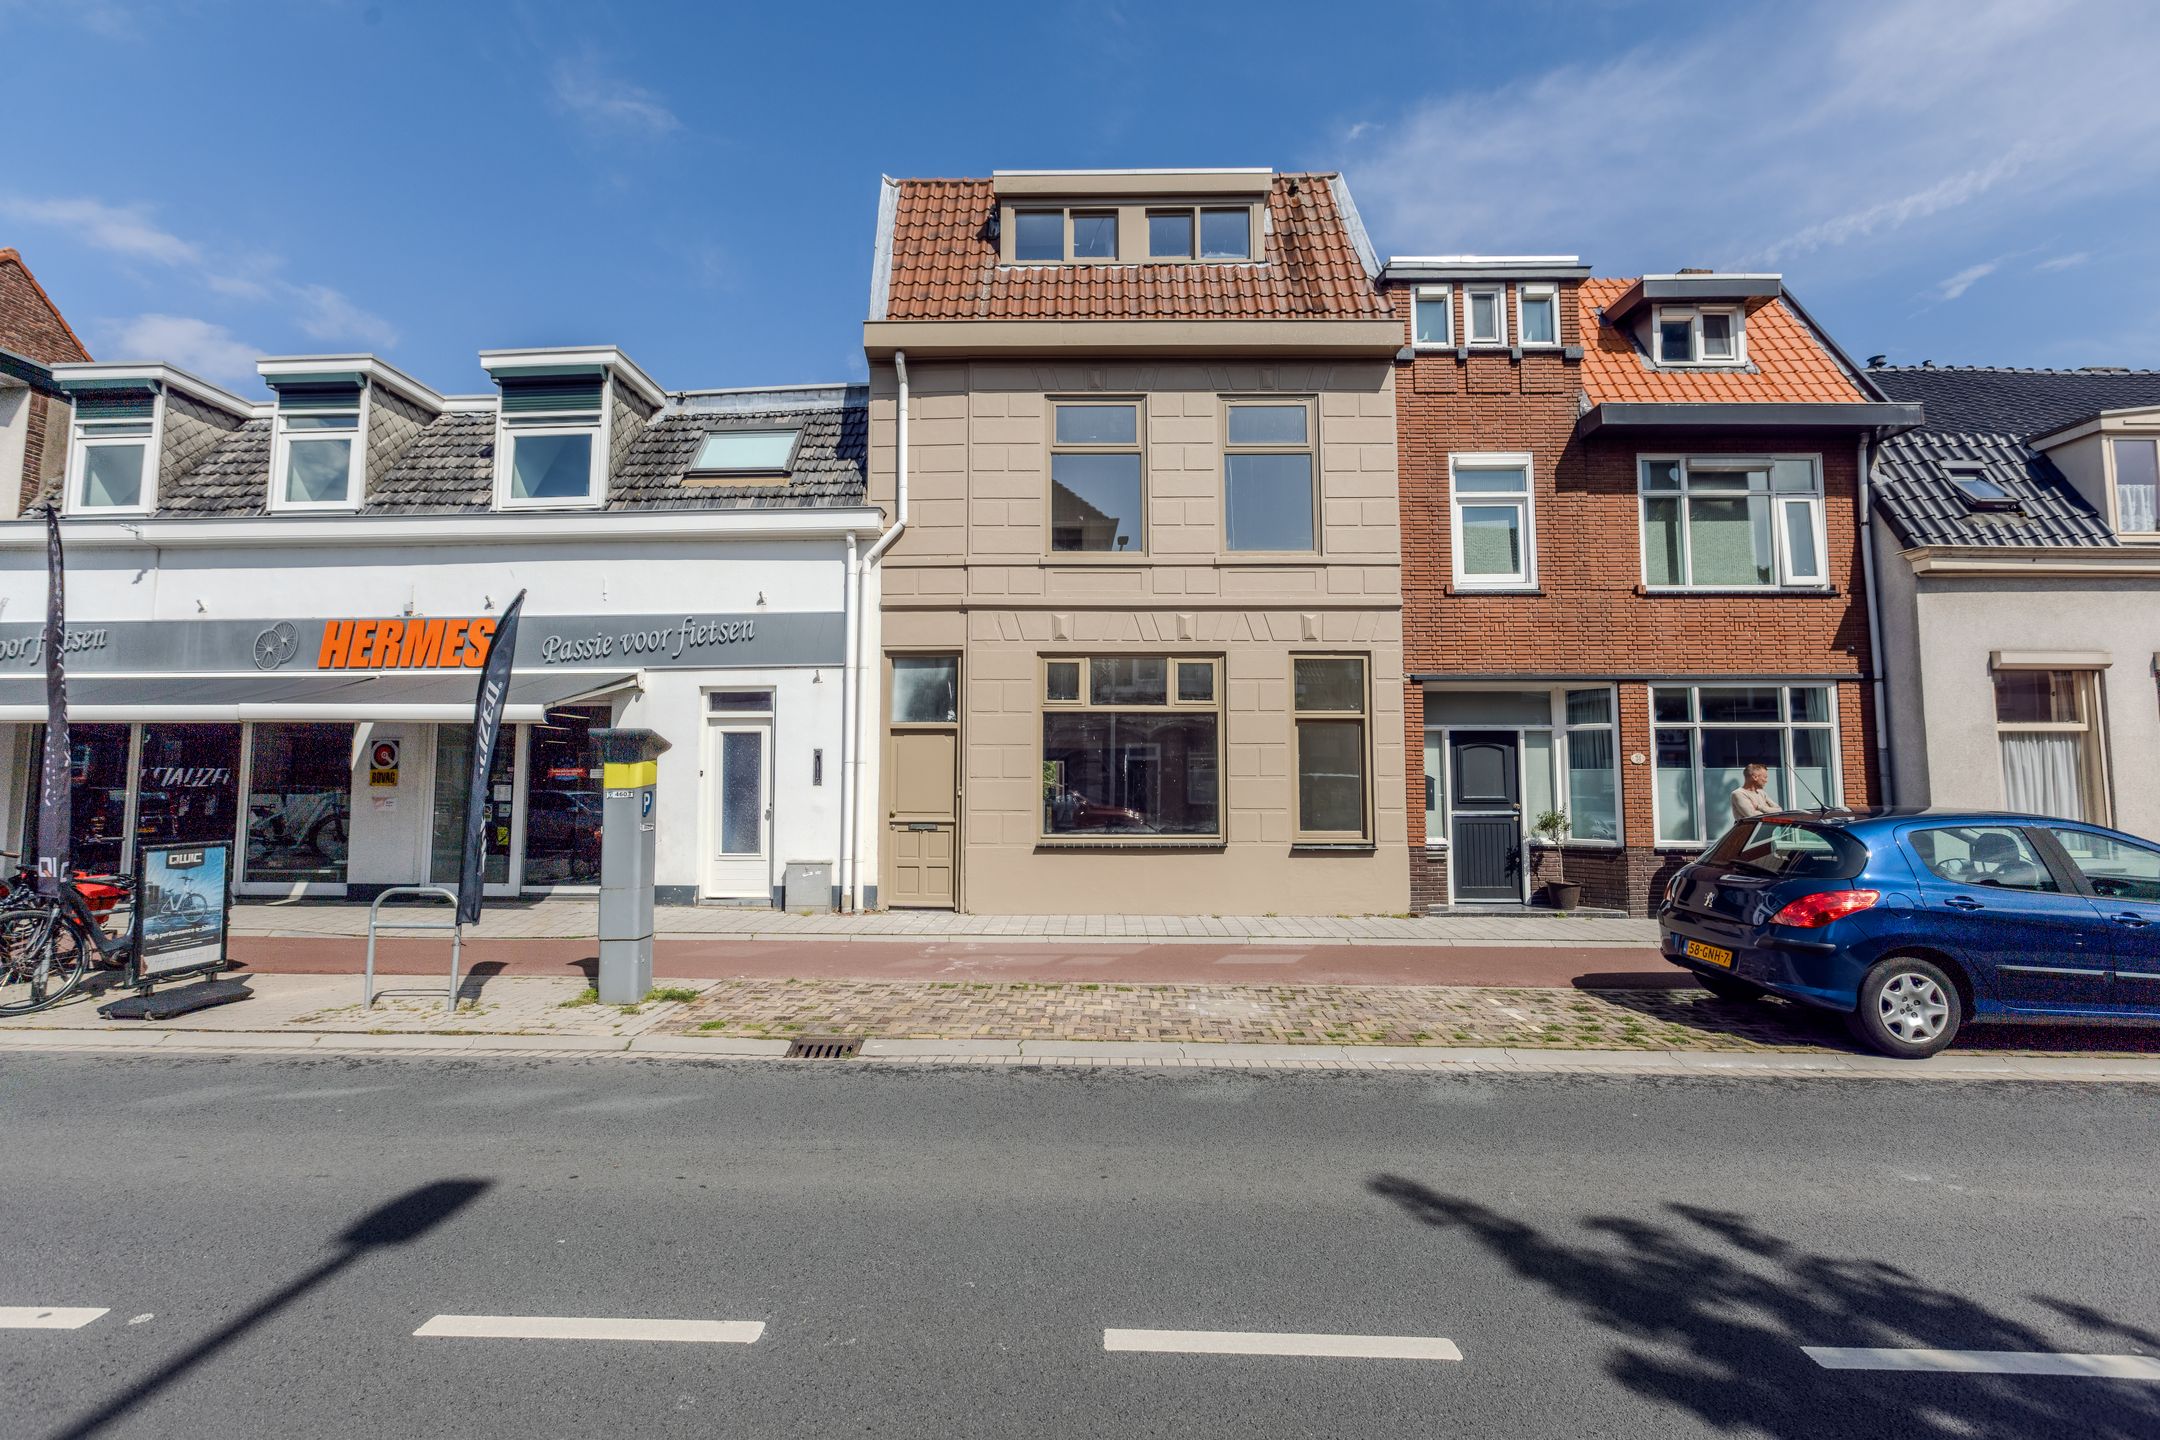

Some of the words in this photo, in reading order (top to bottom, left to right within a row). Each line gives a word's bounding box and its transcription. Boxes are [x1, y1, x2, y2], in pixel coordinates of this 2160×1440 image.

[0, 637, 32, 660] oor
[29, 624, 107, 666] ftsen
[318, 618, 496, 669] HERMES
[542, 632, 613, 663] Passie
[620, 628, 672, 655] voor
[672, 616, 755, 659] fietsen
[371, 772, 395, 784] BOVAG
[643, 793, 651, 813] P
[168, 853, 203, 865] QWIC
[1689, 943, 1730, 964] 58-GNH-7
